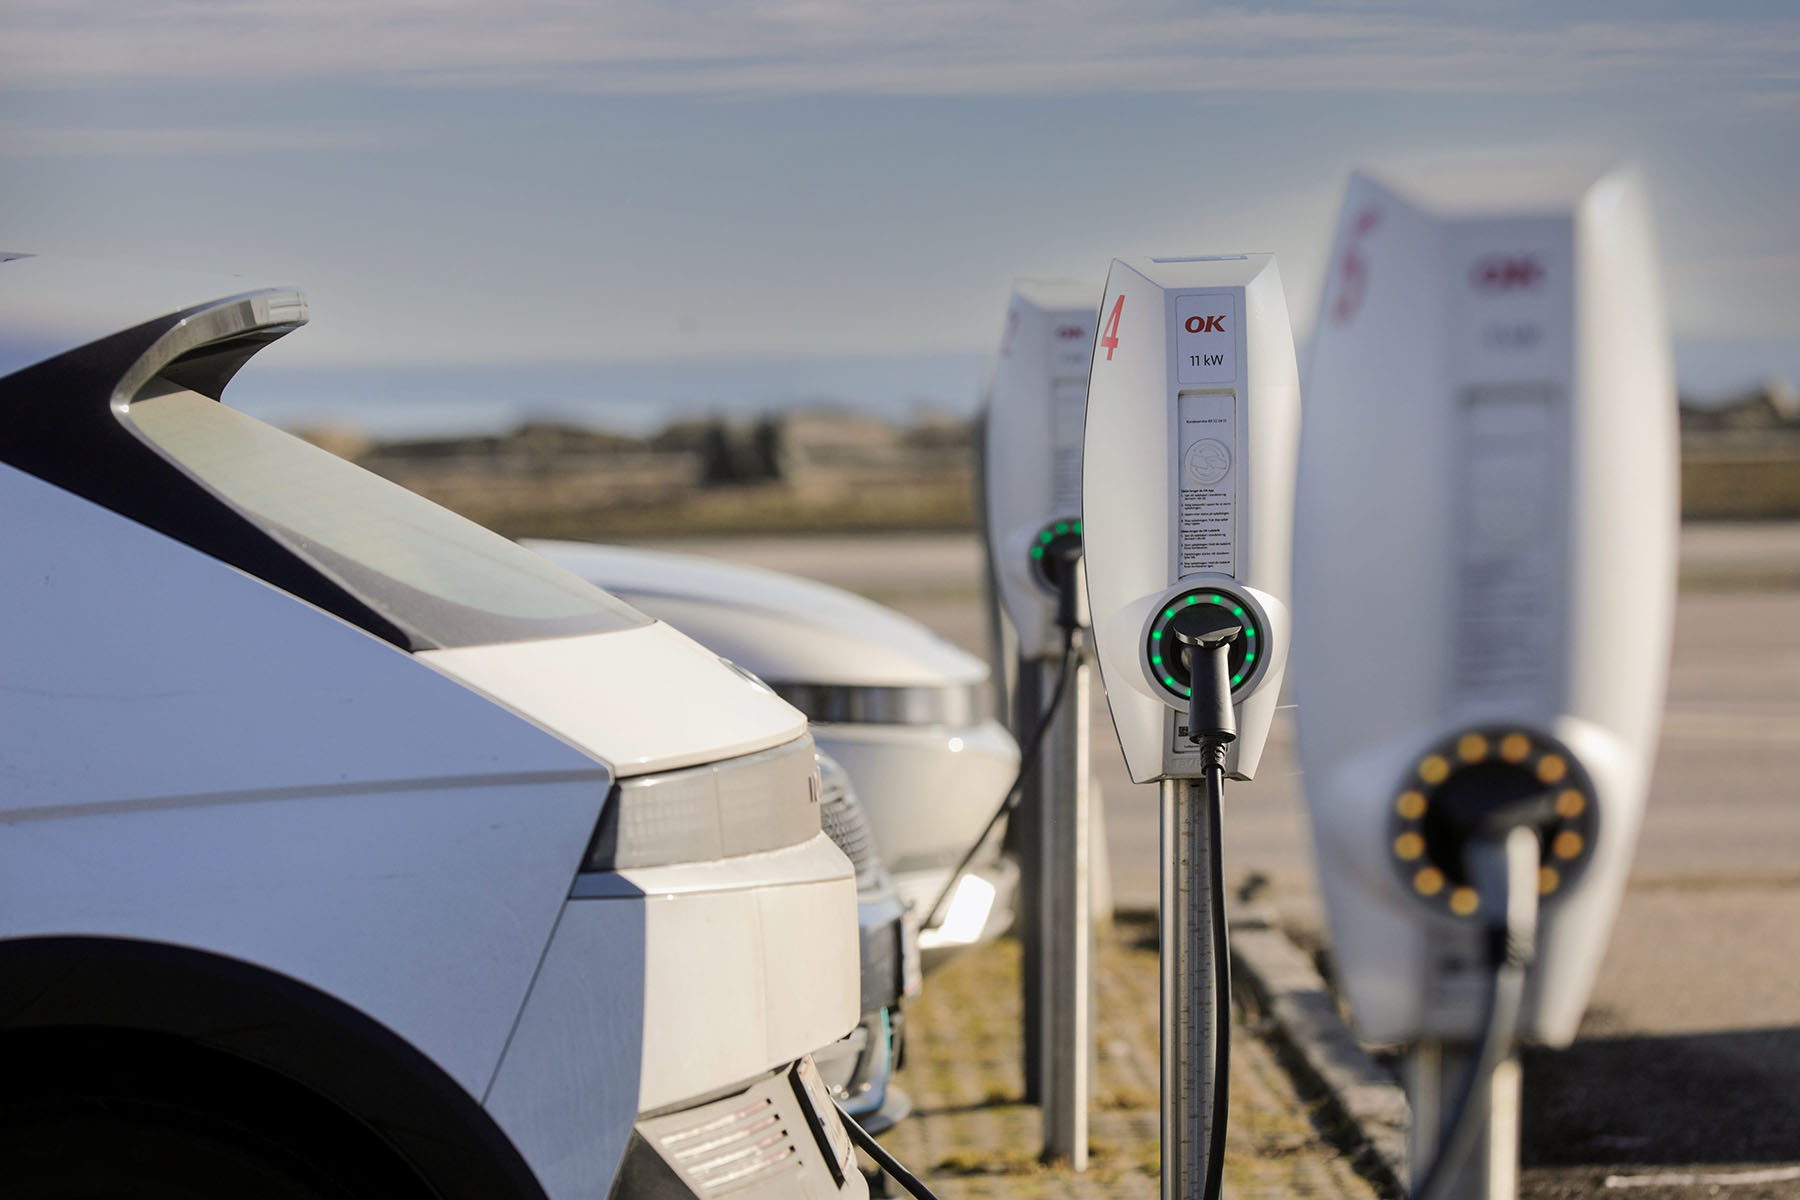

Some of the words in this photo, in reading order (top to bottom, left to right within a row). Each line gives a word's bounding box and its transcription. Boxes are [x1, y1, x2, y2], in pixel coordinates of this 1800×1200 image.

[1101, 294, 1125, 361] 4
[1185, 315, 1227, 333] OK
[1190, 355, 1200, 366] 11
[1204, 354, 1224, 366] kW
